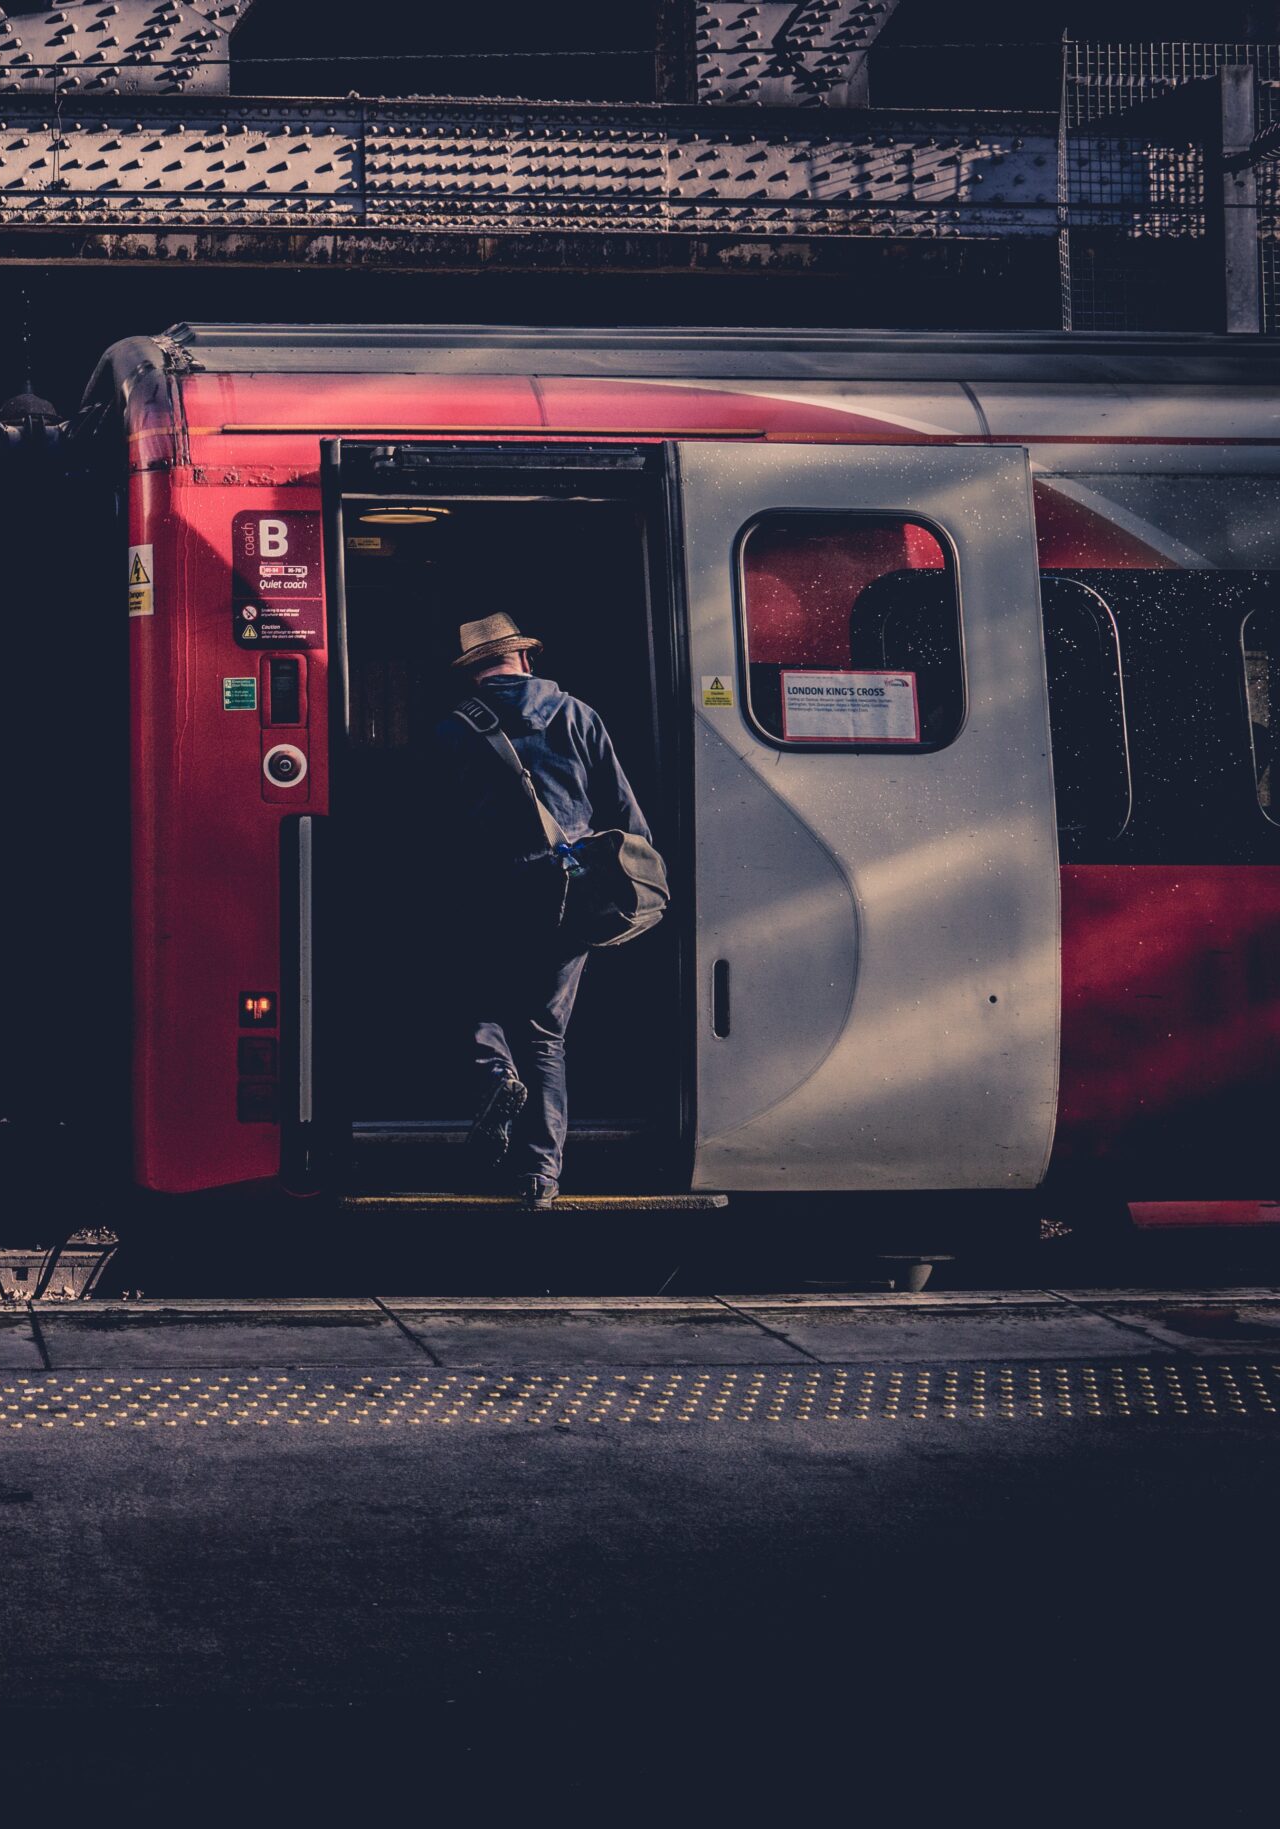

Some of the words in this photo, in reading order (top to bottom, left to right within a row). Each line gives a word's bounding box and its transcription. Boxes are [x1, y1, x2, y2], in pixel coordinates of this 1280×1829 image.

[241, 522, 255, 556] coach
[259, 519, 289, 558] B
[259, 579, 282, 590] Quiet
[283, 580, 308, 589] coach
[787, 686, 824, 695] LONDON
[826, 687, 855, 696] KING'S
[856, 688, 886, 697] CROSS
